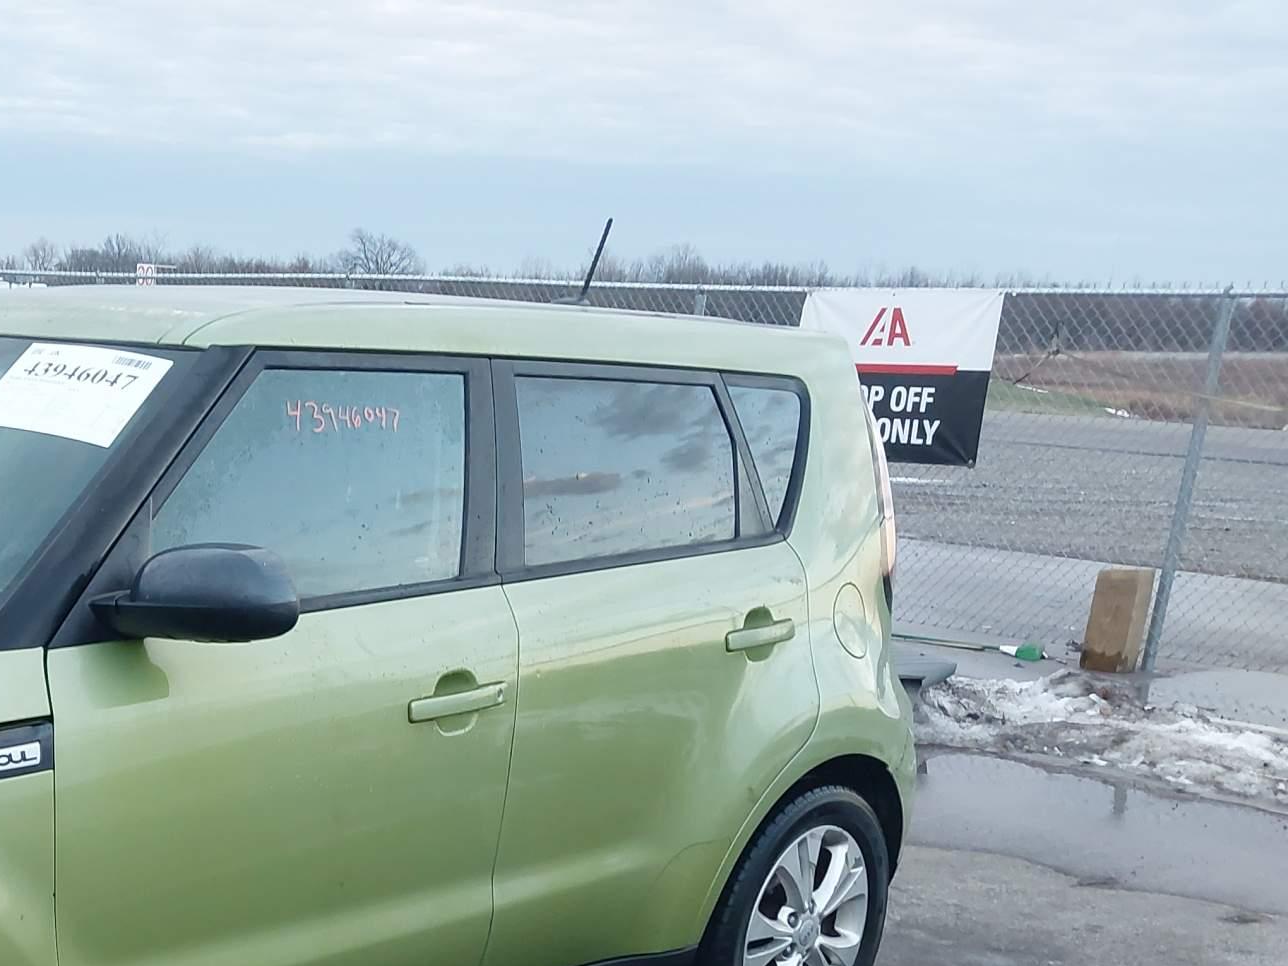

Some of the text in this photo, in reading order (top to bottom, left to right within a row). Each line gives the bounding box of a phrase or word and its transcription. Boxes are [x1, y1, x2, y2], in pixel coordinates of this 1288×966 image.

[23, 361, 139, 390] 43946047
[889, 386, 936, 413] OFF
[286, 399, 400, 432] 43946047
[876, 416, 941, 446] ONLY
